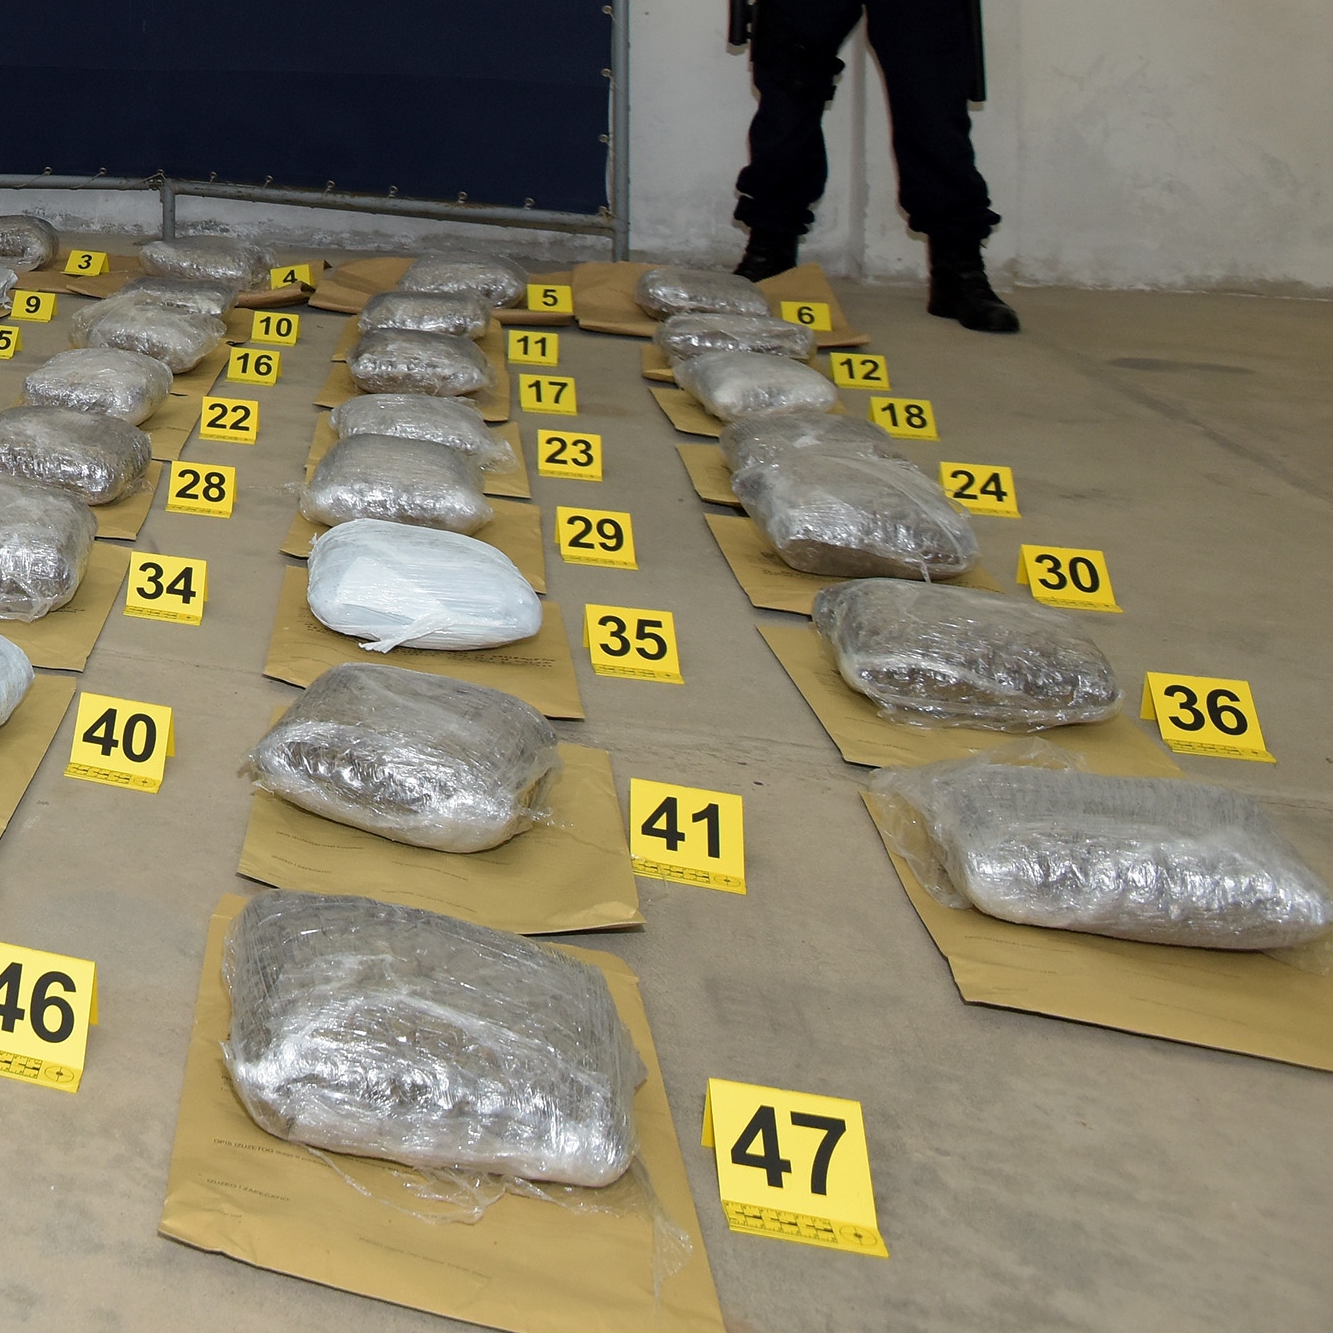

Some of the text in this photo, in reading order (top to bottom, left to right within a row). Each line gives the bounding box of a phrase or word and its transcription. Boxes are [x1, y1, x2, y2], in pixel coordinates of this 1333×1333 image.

[78, 255, 92, 269] 3
[283, 270, 298, 284] 4
[26, 296, 40, 313] 9
[543, 289, 558, 306] 5
[260, 317, 292, 337] 10
[798, 307, 814, 324] 6
[517, 336, 546, 356] 11
[237, 353, 272, 375] 16
[841, 358, 881, 380] 12
[529, 381, 567, 403] 17
[207, 404, 250, 431] 22
[882, 403, 927, 428] 18
[546, 437, 593, 466] 23
[176, 470, 225, 502] 28
[951, 470, 1007, 501] 24
[568, 516, 623, 551] 29
[137, 563, 196, 604] 34
[1036, 555, 1099, 593] 30
[599, 616, 667, 660] 35
[1164, 685, 1247, 735] 36
[83, 709, 156, 762] 40
[642, 797, 719, 858] 41
[731, 1106, 846, 1195] 47
